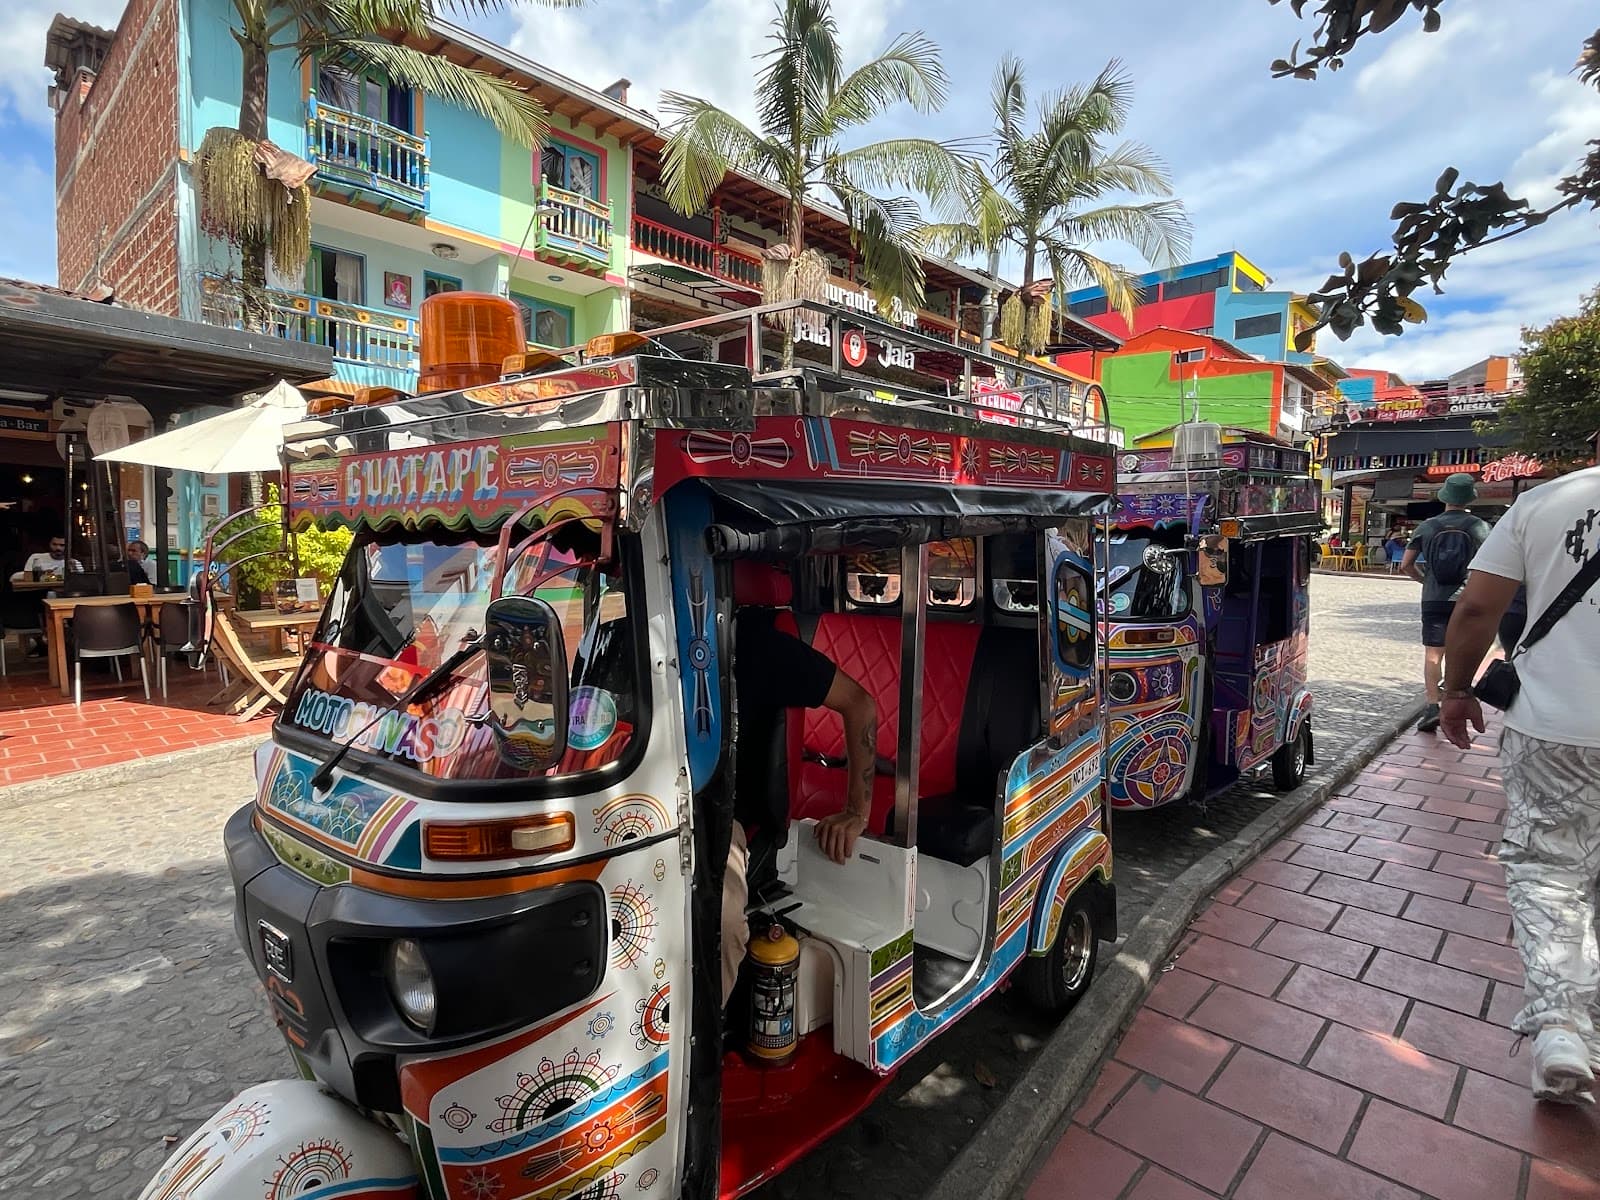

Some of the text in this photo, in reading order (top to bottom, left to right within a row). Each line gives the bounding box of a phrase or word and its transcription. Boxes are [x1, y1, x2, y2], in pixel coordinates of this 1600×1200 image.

[890, 295, 917, 327] Bar
[877, 340, 915, 370] Jala
[345, 445, 500, 504] GUATAPE
[1481, 458, 1544, 483] Florida
